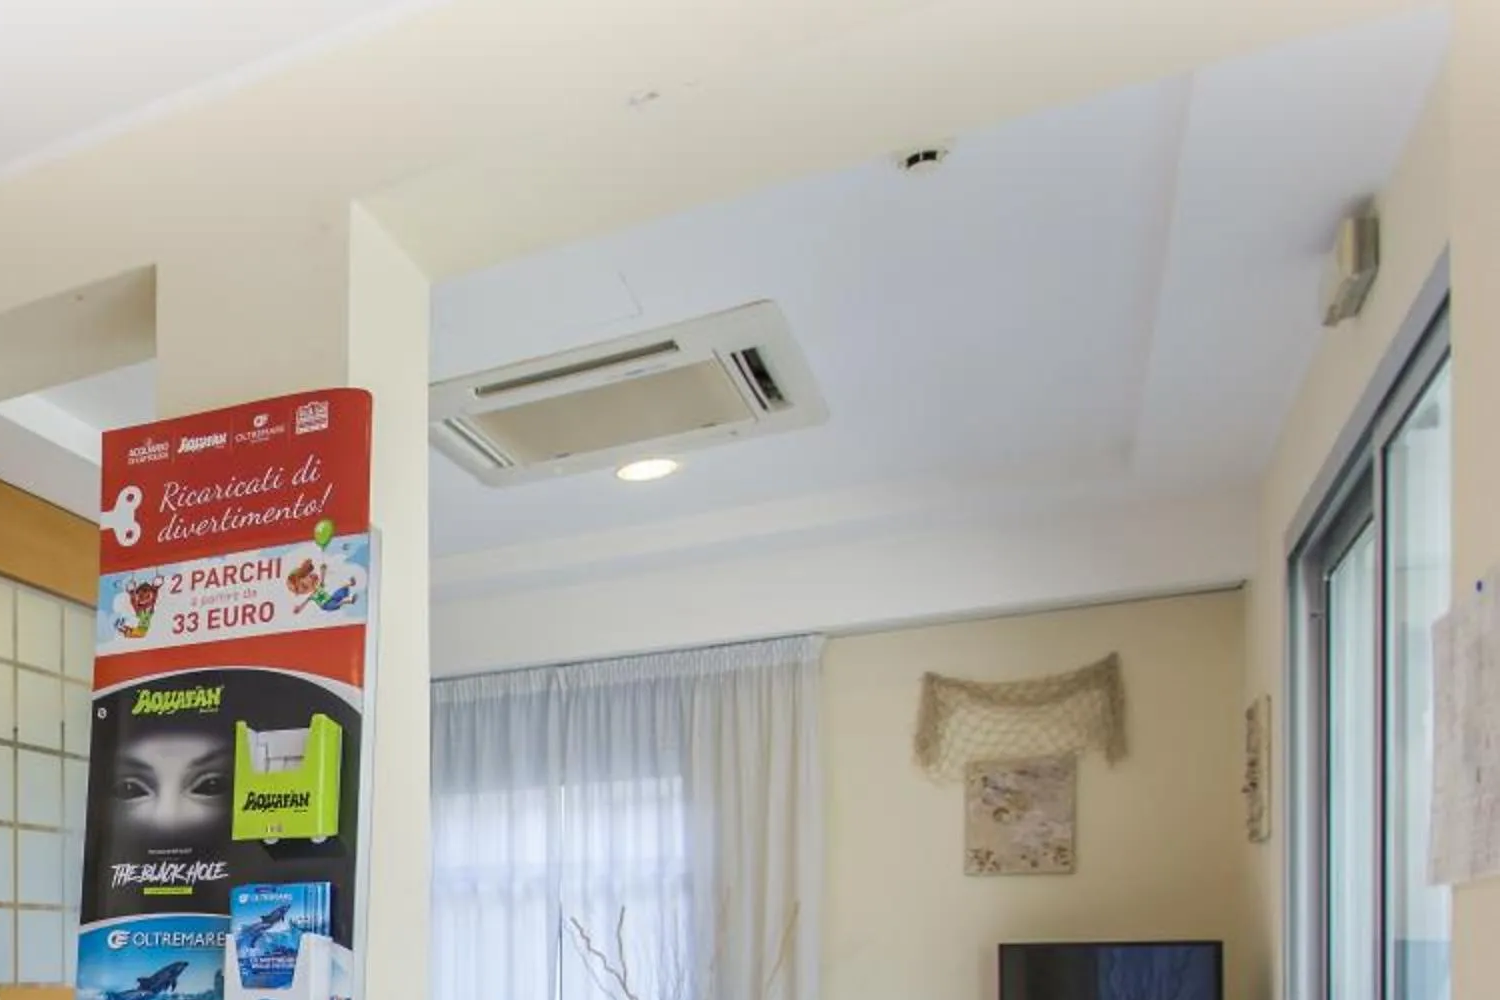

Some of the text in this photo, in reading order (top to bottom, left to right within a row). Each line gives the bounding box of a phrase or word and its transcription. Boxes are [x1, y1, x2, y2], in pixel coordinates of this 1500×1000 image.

[159, 454, 321, 513] Ricaricati di
[157, 483, 332, 543] divertimento!
[169, 557, 282, 594] 2 PARCHI
[172, 601, 275, 634] 33 EURO
[111, 861, 229, 888] THE BLACK HOLE
[132, 930, 226, 948] OLTREMARE
